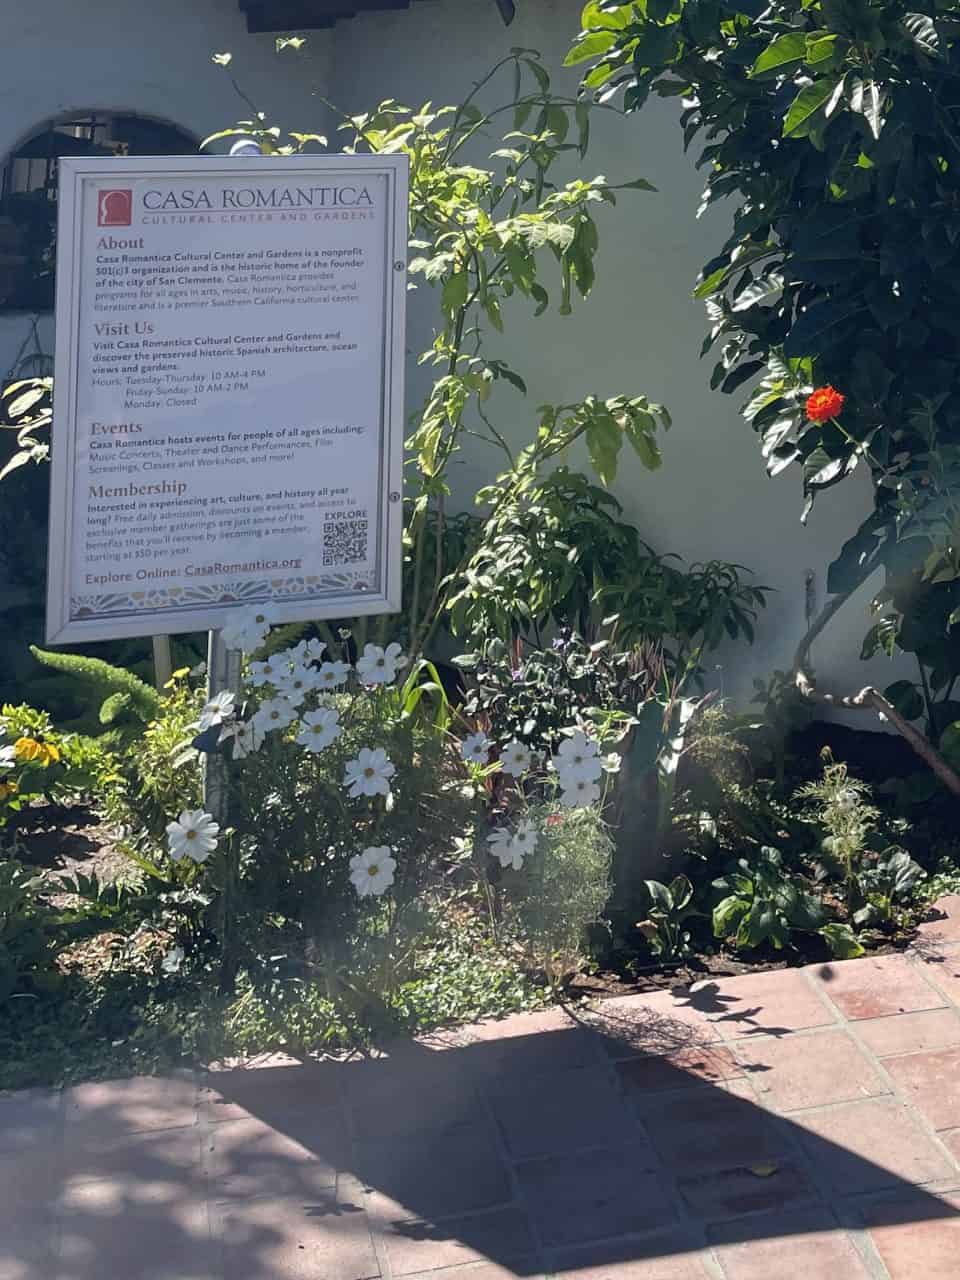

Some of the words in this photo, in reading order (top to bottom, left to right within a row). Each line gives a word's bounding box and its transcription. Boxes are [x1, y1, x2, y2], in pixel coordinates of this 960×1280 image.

[142, 189, 212, 209] CASA
[221, 186, 374, 208] ROMANTICA
[141, 215, 215, 225] CULTURAL
[220, 213, 273, 223] CENTER
[280, 213, 306, 221] AND
[314, 211, 375, 220] GARDENS
[96, 236, 144, 250] About
[96, 255, 119, 263] Casa
[121, 253, 171, 262] Romantica
[174, 252, 211, 261] Cultural
[214, 251, 244, 260] Center
[247, 250, 263, 259] and
[266, 249, 302, 258] Gardens
[321, 247, 362, 257] nonprofit
[95, 266, 128, 276] 501(c)3
[131, 264, 189, 275] organization
[191, 263, 208, 272] and
[221, 263, 235, 271] the
[238, 262, 272, 271] historic
[274, 261, 298, 269] home
[313, 260, 327, 268] the
[330, 259, 364, 267] founder
[95, 279, 107, 287] of
[108, 278, 123, 287] the
[126, 278, 143, 287] city
[146, 277, 157, 285] of
[158, 277, 175, 285] San
[226, 274, 248, 283] Casa
[250, 273, 296, 282] Romantica
[298, 271, 334, 282] provides
[95, 292, 136, 301] programs
[167, 290, 187, 298] ages
[341, 282, 356, 290] and
[94, 303, 136, 311] literature
[137, 301, 155, 309] and
[253, 296, 294, 305] California
[296, 295, 329, 303] cultural
[94, 322, 129, 336] Visit
[134, 321, 154, 334] Us
[93, 341, 114, 350] Visit
[117, 340, 139, 349] Casa
[142, 338, 192, 347] Romantica
[194, 336, 231, 345] Cultural
[233, 335, 264, 343] Center
[267, 333, 283, 342] and
[286, 332, 322, 341] Gardens
[324, 331, 340, 339] and
[92, 353, 131, 362] discover
[134, 351, 149, 360] the
[152, 349, 196, 360] preserved
[199, 348, 234, 357] historic
[237, 346, 270, 356] Spanish
[272, 344, 328, 353] architecture,
[92, 365, 118, 374] views
[121, 364, 138, 372] and
[250, 369, 266, 378] PM
[233, 382, 248, 390] PM
[165, 397, 197, 406] Closed
[89, 421, 143, 435] Events
[89, 440, 112, 449] Casa
[115, 437, 165, 447] Romantica
[167, 435, 192, 444] hosts
[195, 433, 225, 442] events
[227, 432, 240, 440] for
[243, 430, 272, 441] people
[275, 429, 286, 437] of
[287, 428, 298, 437] all
[300, 429, 320, 437] ages
[322, 425, 364, 434] including:
[89, 452, 116, 461] Music
[164, 447, 200, 456] Theater
[202, 445, 218, 454] and
[220, 444, 248, 453] Dance
[142, 461, 176, 470] Classes
[178, 459, 194, 468] and
[250, 454, 266, 463] and
[88, 479, 186, 498] Membership
[87, 501, 136, 513] Interested
[150, 496, 207, 509] experiencing
[210, 495, 225, 504] art,
[265, 490, 281, 500] and
[284, 490, 315, 498] history
[317, 487, 328, 496] all
[329, 488, 349, 496] year
[87, 515, 111, 526] long?
[114, 514, 134, 523] Free
[136, 512, 156, 522] daily
[324, 509, 367, 520] EXPLORE
[86, 527, 127, 537] exclusive
[129, 524, 167, 534] member
[169, 521, 216, 533] gatherings
[233, 518, 250, 528] just
[253, 517, 276, 525] some
[289, 513, 304, 522] the
[85, 539, 122, 549] benefits
[125, 537, 143, 546] that
[172, 533, 203, 542] receive
[85, 552, 120, 562] starting
[134, 549, 151, 558] $50
[85, 571, 133, 585] Explore
[135, 567, 180, 580] Online:
[184, 558, 302, 576] CasaRomantica.org
